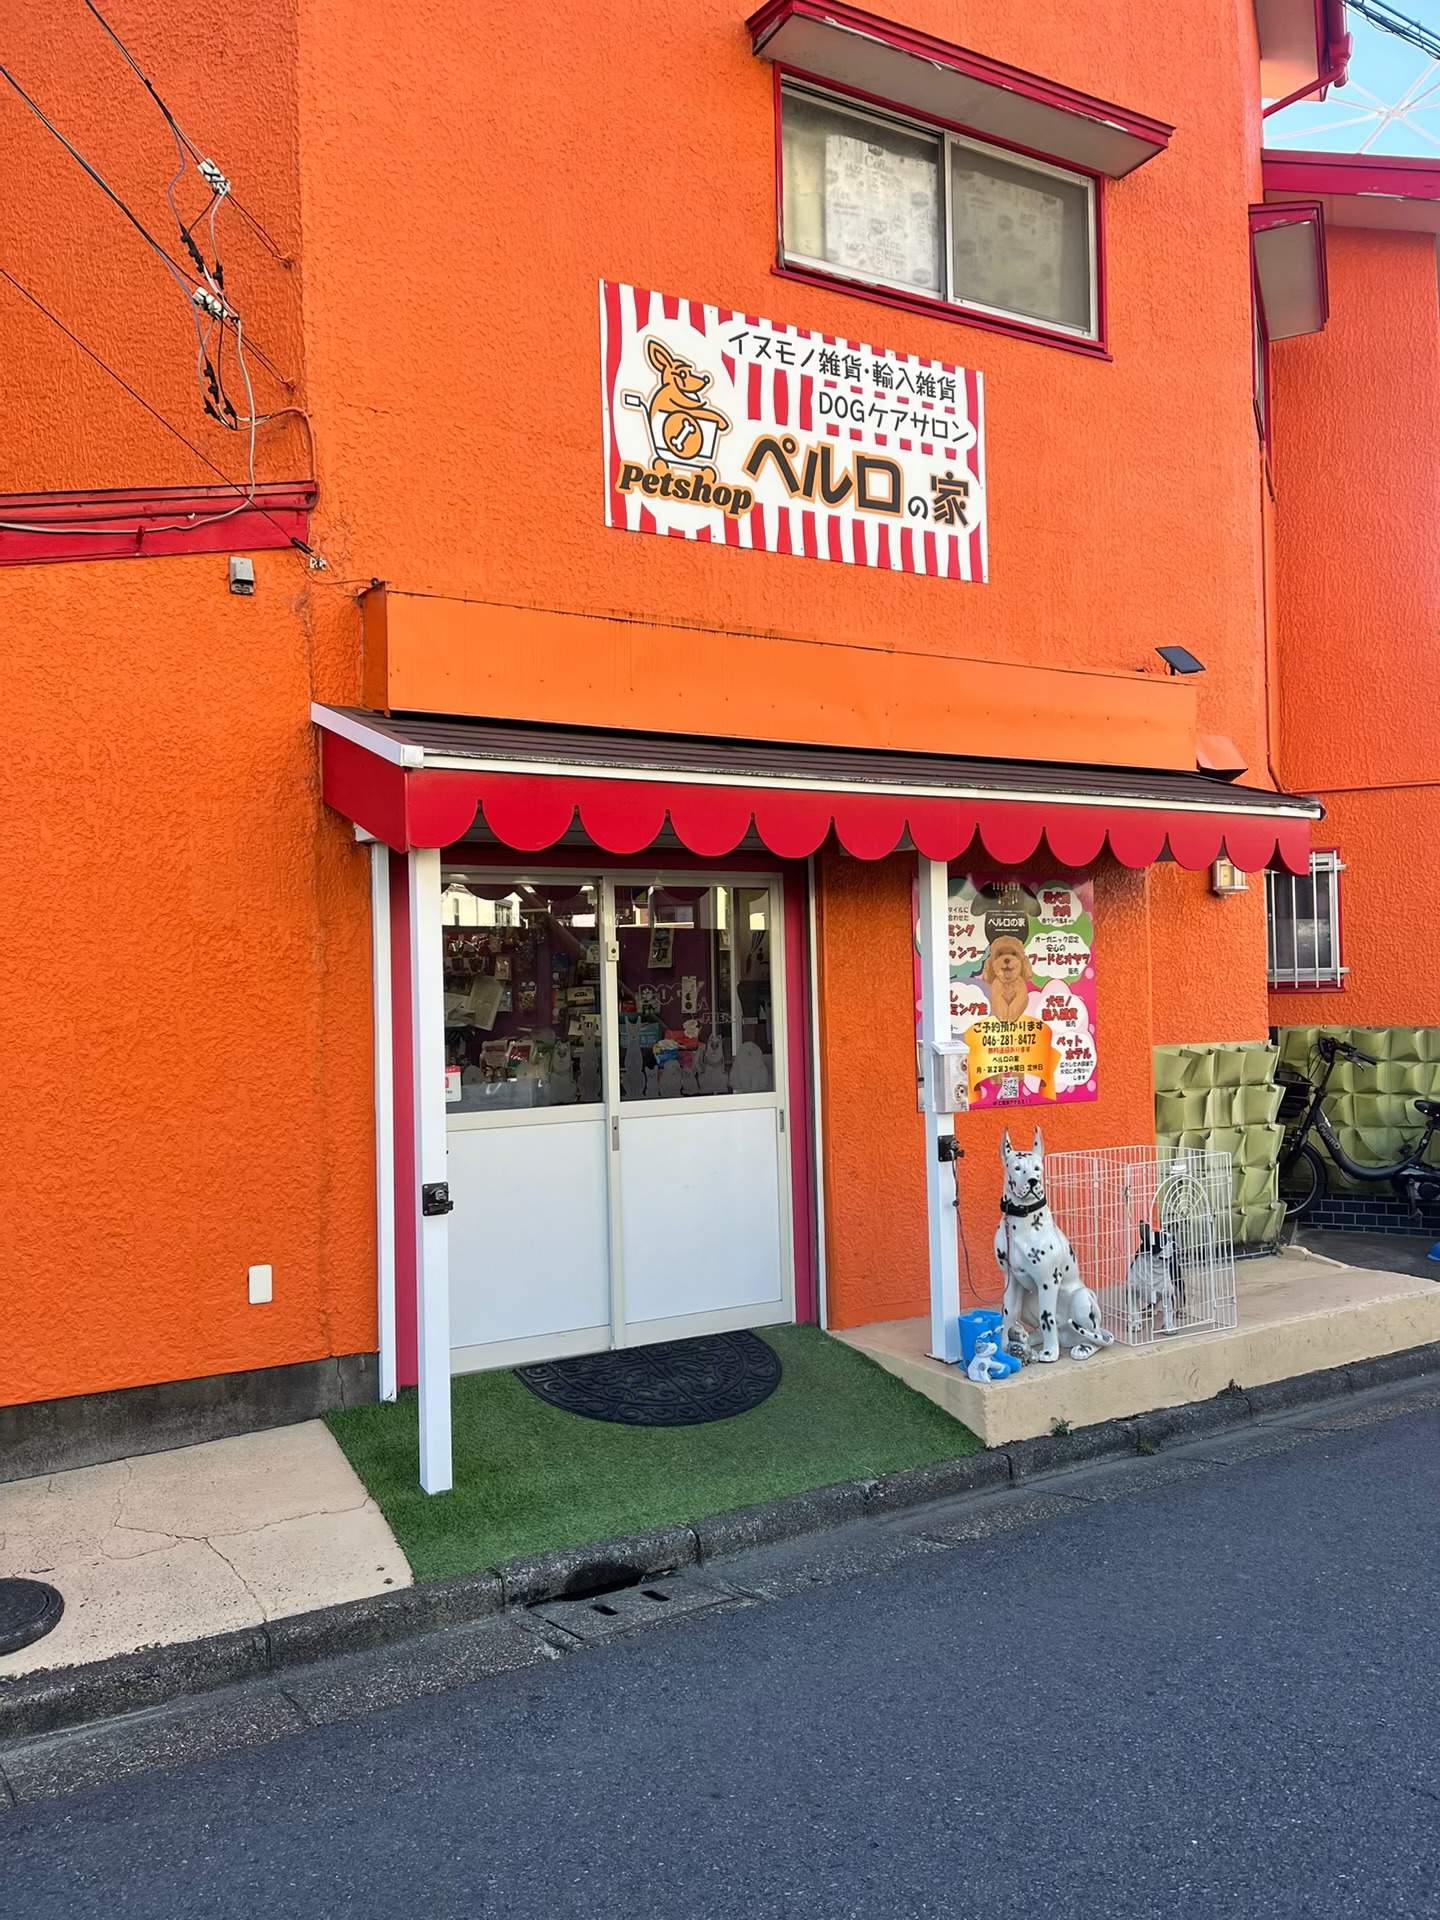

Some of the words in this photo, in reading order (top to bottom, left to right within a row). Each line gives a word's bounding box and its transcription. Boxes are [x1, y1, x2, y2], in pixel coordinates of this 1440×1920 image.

[728, 331, 957, 404] イヌモノ雑貨・輸入雑貨
[819, 391, 969, 443] DOGケアサロン
[619, 464, 753, 516] Petshop
[746, 437, 970, 527] ペルロの家
[1028, 952, 1091, 966] フードとオヤツ
[982, 1034, 1037, 1046] 046-281-8472
[1056, 1034, 1083, 1047] ペット
[1065, 1047, 1092, 1060] ホテル
